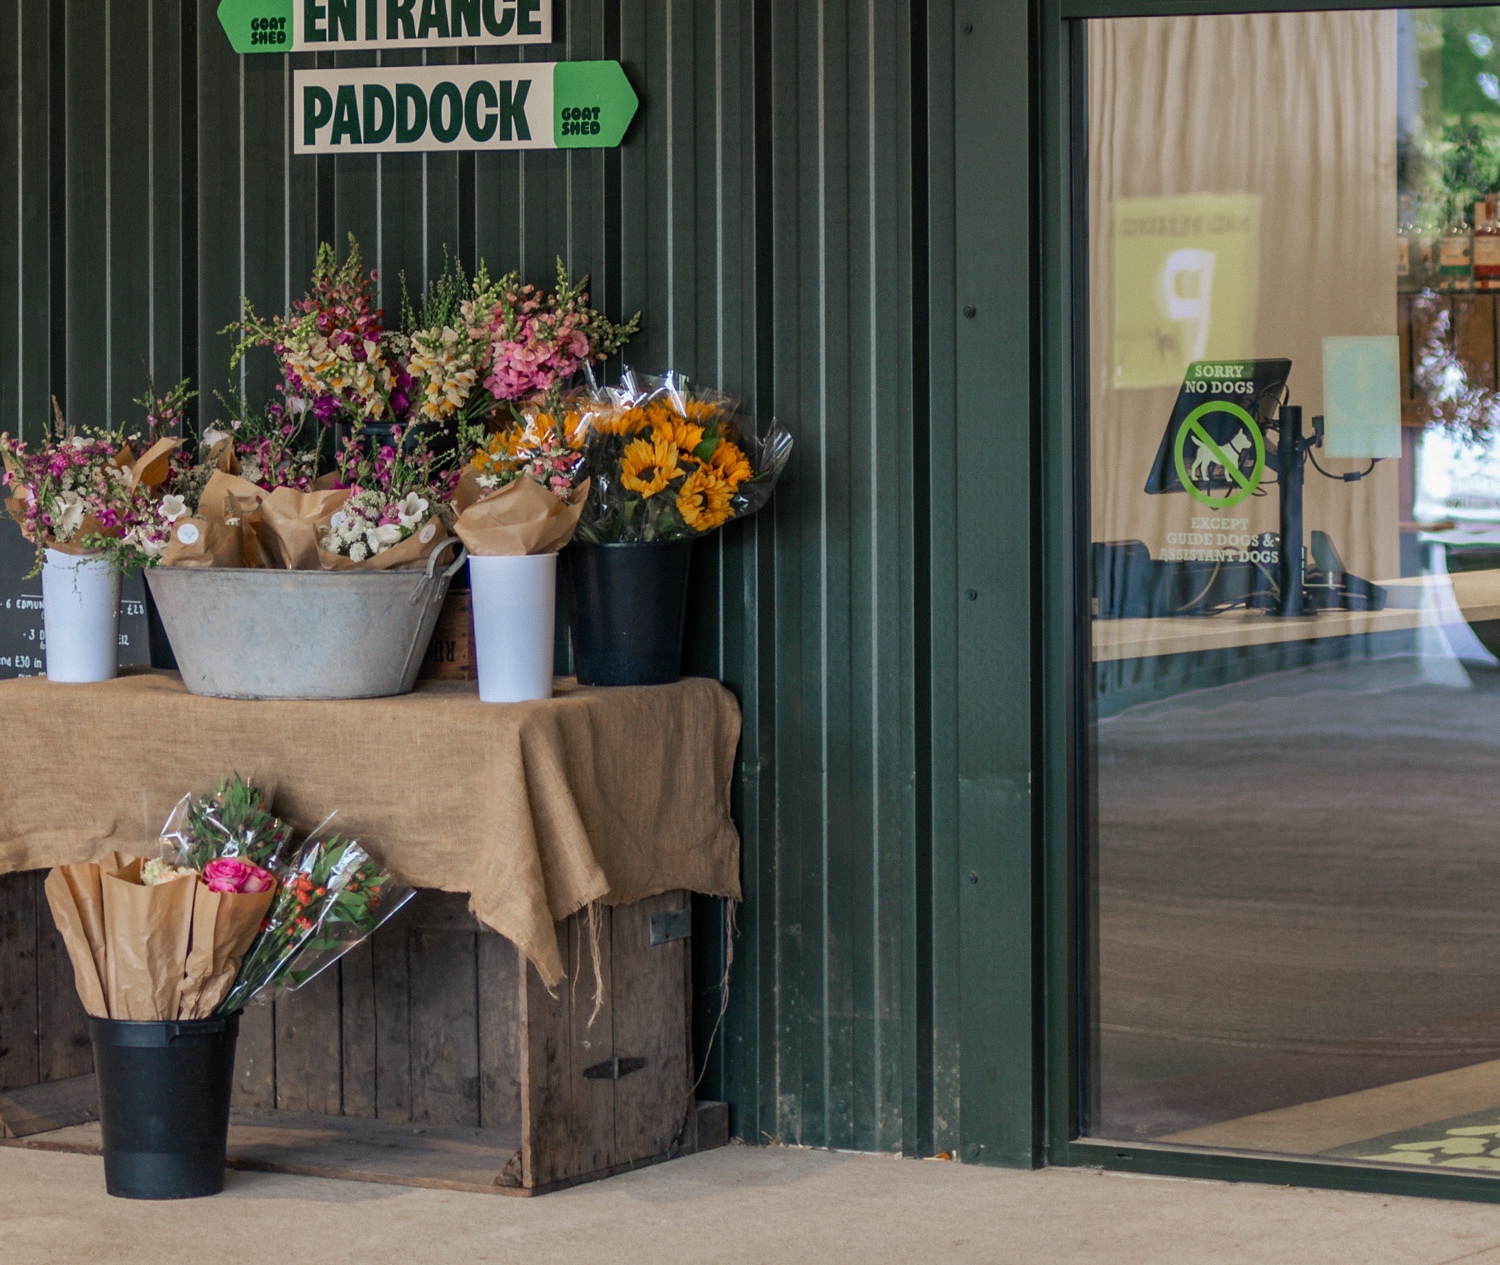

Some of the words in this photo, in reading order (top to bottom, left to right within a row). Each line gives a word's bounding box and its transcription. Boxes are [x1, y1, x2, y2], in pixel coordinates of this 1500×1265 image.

[251, 17, 286, 31] GOAT
[251, 31, 286, 45] SHED
[303, 79, 532, 146] PADDOCK
[561, 107, 601, 121] GOAT
[561, 121, 601, 135] SHED
[1195, 365, 1244, 378] SORRY
[1185, 381, 1208, 393] NO
[1211, 381, 1254, 394] DOGS
[1191, 517, 1249, 530] EXCEPT
[1166, 532, 1213, 545] GUIDE
[1217, 534, 1259, 547] DOGS
[1263, 532, 1274, 547] &
[1159, 548, 1234, 562] ASSISTANT
[1238, 550, 1279, 563] DOGS
[6, 599, 11, 609] 6
[127, 604, 145, 615] £28
[29, 629, 35, 640] 3
[15, 655, 31, 668] £30
[34, 657, 42, 668] in
